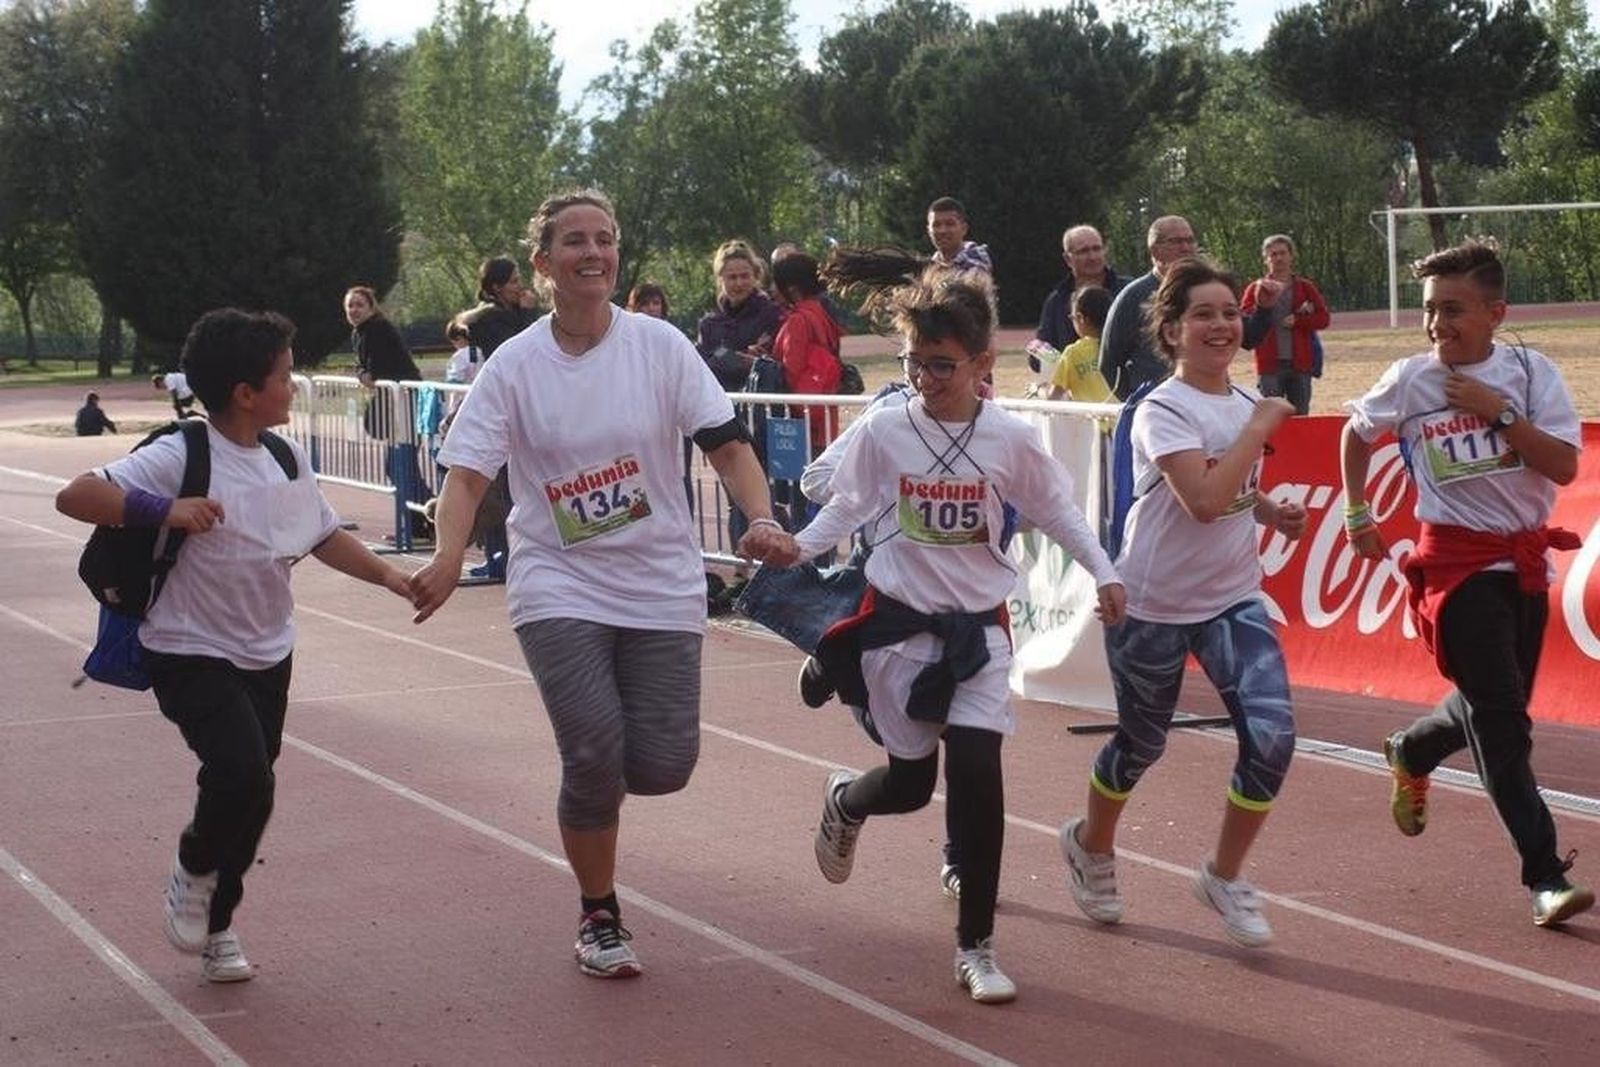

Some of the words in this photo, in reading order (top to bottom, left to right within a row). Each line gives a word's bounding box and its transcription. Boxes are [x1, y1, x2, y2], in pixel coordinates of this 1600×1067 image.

[1443, 431, 1497, 462] 111
[546, 460, 639, 502] bedunia
[901, 477, 986, 500] beduni
[571, 482, 631, 524] 134
[919, 501, 979, 530] 105
